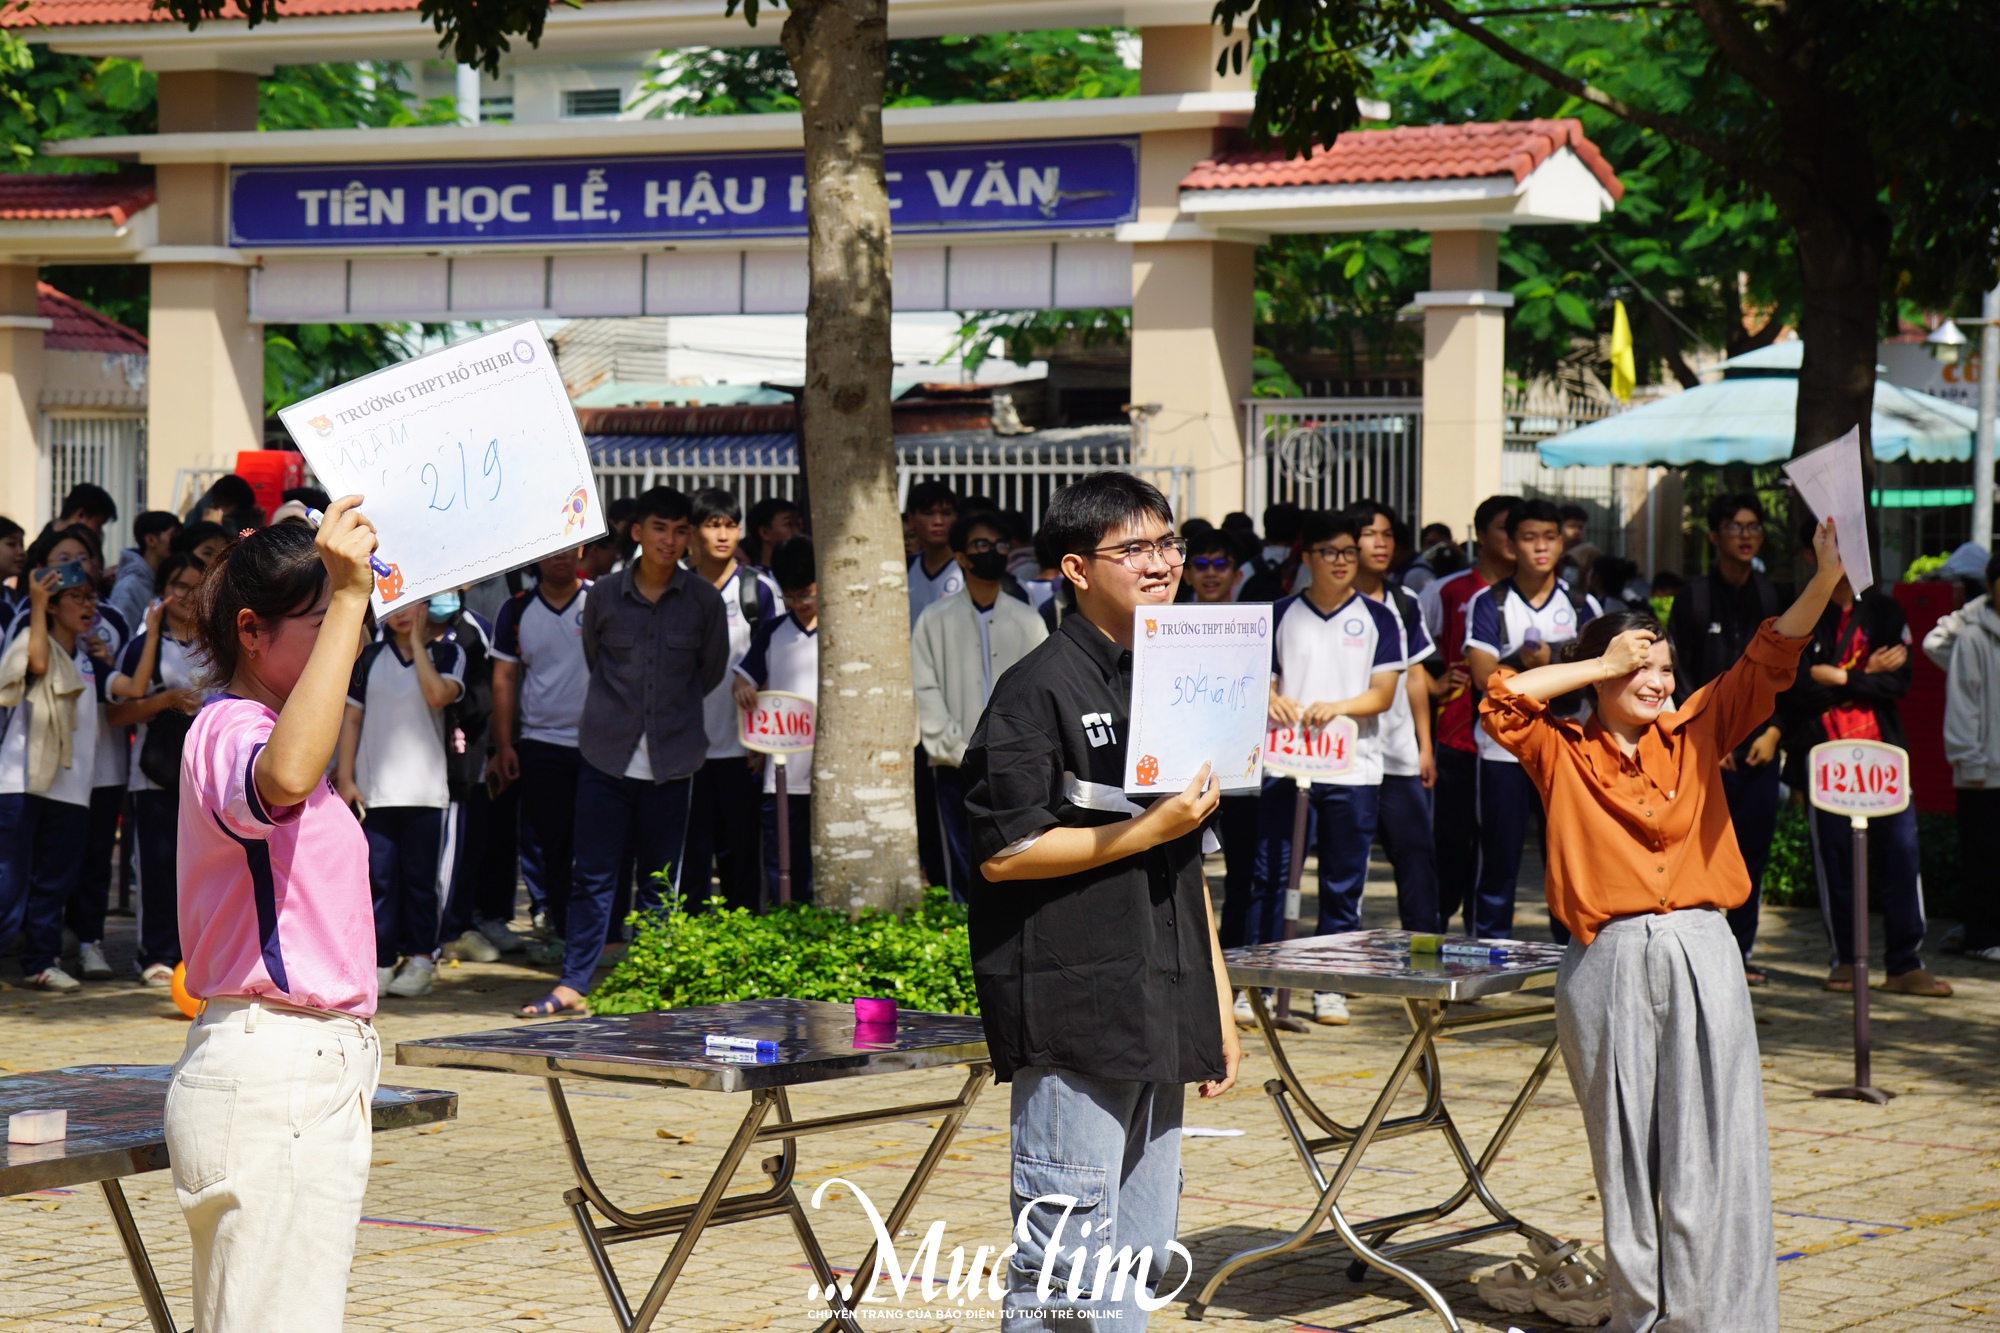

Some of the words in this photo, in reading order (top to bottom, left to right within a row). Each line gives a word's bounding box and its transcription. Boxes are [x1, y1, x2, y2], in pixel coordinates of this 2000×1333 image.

[297, 180, 404, 226] TIÊN
[426, 185, 531, 232] HỌC
[553, 168, 621, 224] LỄ,
[644, 171, 766, 224] HẬU
[926, 160, 1060, 210] VĂN
[335, 389, 406, 426] TRƯỜNG
[405, 374, 447, 400] THPT
[445, 361, 470, 385] HỒ
[469, 356, 500, 375] THỊ
[498, 351, 515, 367] BI
[421, 438, 502, 511] 2/9
[1160, 620, 1201, 636] TRƯỜNG
[1202, 622, 1224, 635] THPT
[1224, 617, 1236, 635] HỒ
[1236, 622, 1250, 638] THỊ
[1250, 622, 1258, 635] BI
[747, 709, 811, 737] 12A06
[1268, 727, 1346, 760] 12A04
[1820, 762, 1898, 795] 12A02
